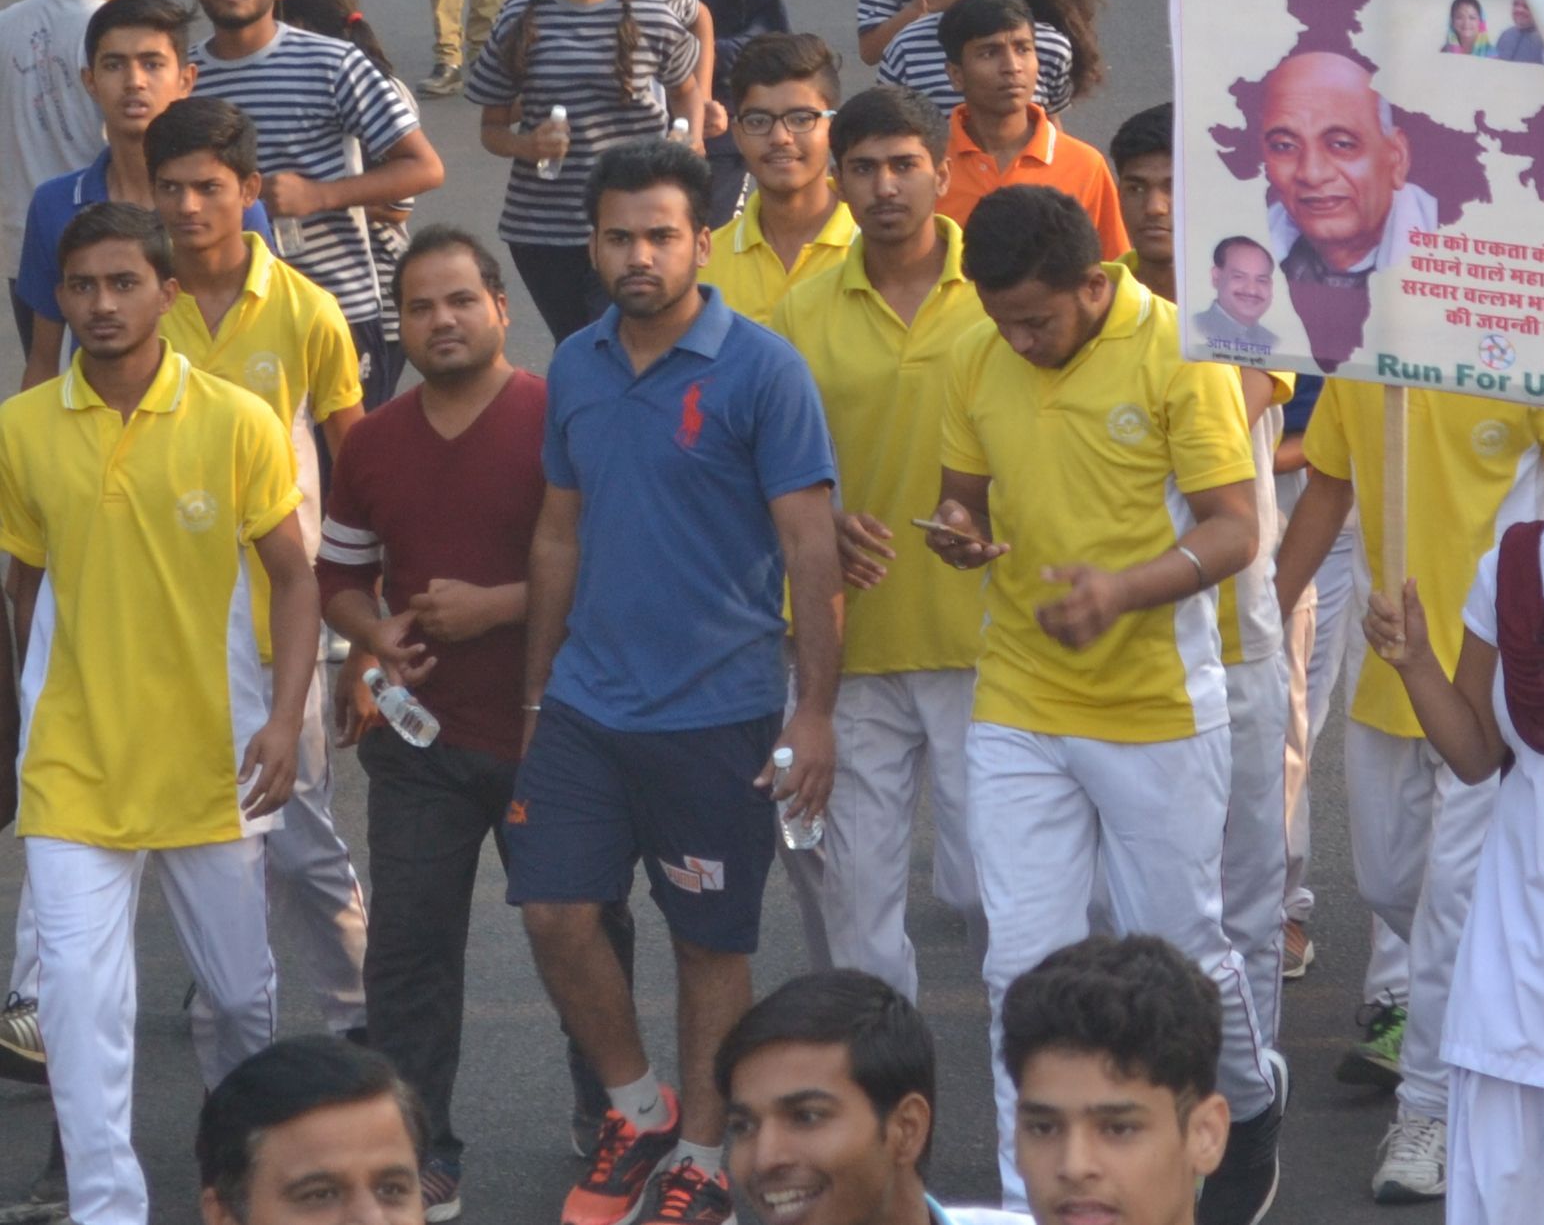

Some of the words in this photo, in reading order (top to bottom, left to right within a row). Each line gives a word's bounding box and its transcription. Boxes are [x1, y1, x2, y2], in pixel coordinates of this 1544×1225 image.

[1408, 227, 1439, 249] देश
[1443, 232, 1469, 253] को
[1473, 238, 1528, 261] एकता
[1410, 253, 1461, 277] बांधने
[1467, 263, 1505, 283] वाले
[1401, 279, 1460, 302] सरदार
[1463, 287, 1523, 309] वल्लभ
[1445, 307, 1471, 327] की
[1476, 312, 1540, 336] जयन्ती
[1378, 353, 1443, 384] Run
[1456, 363, 1511, 392] For
